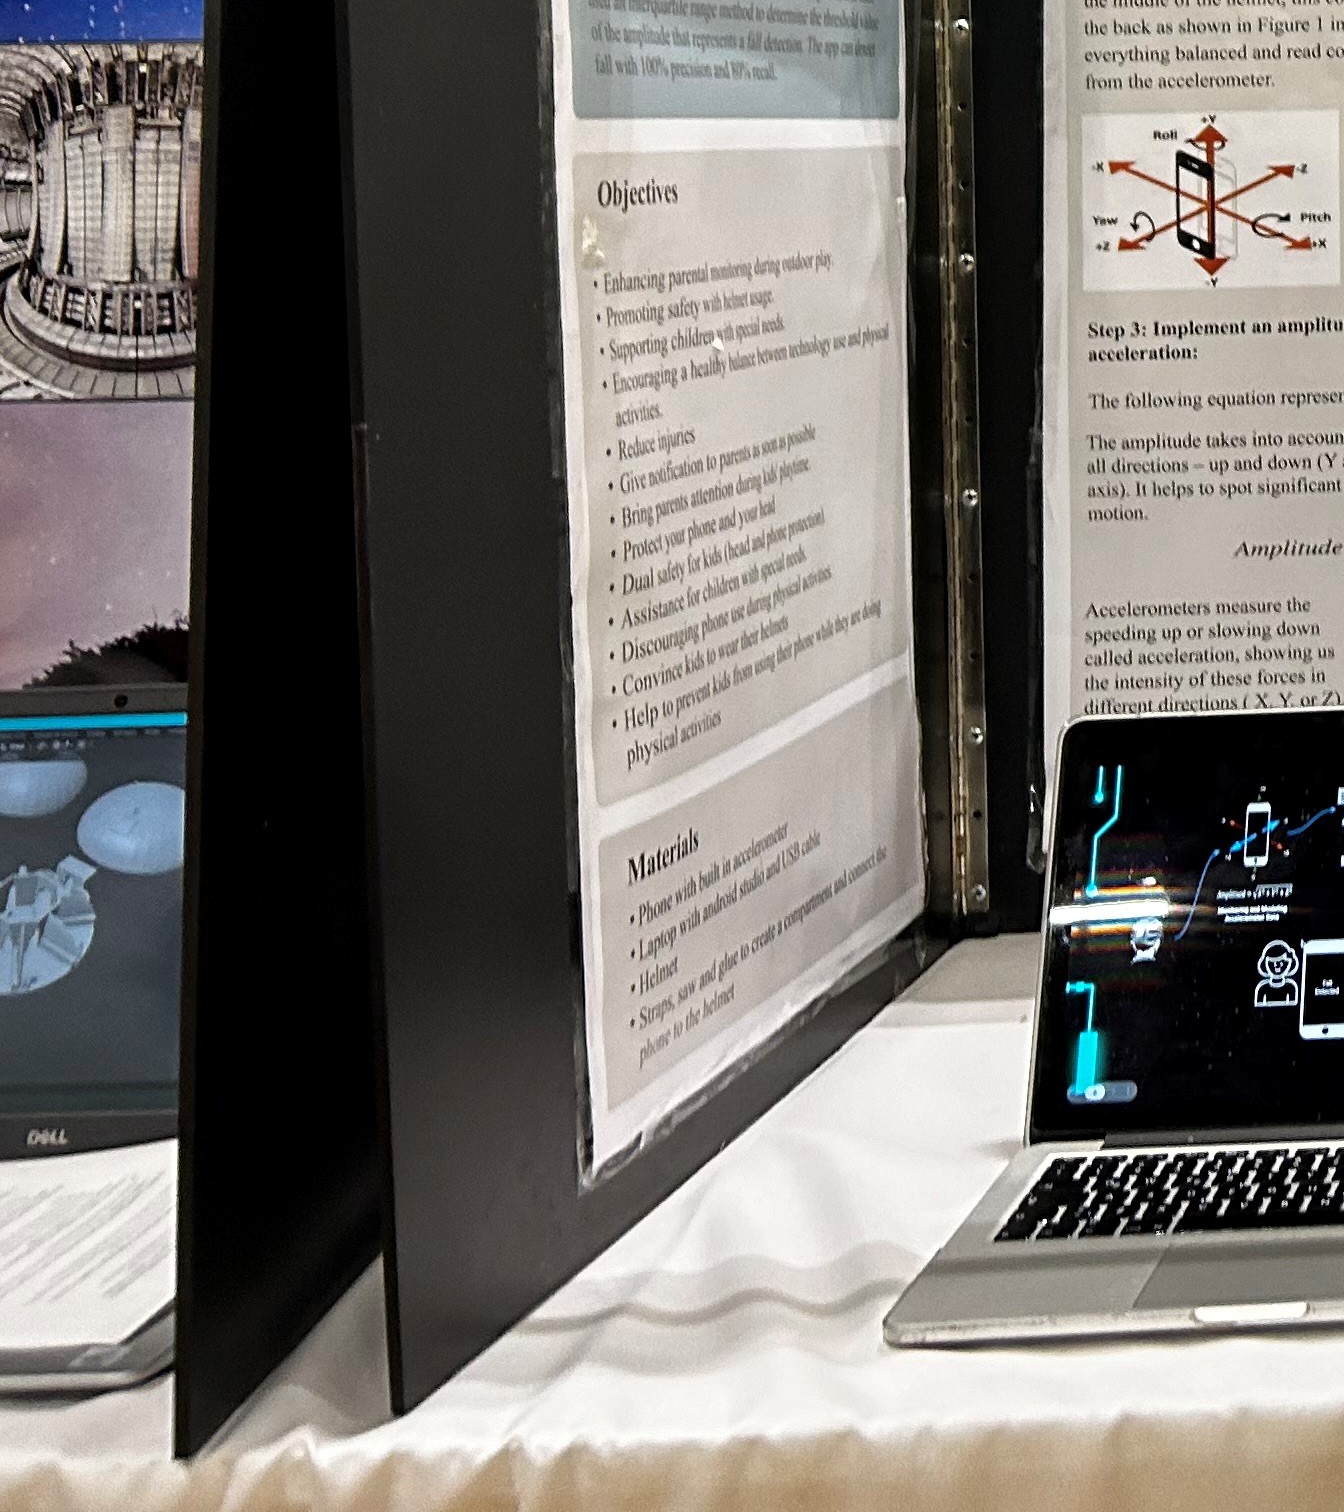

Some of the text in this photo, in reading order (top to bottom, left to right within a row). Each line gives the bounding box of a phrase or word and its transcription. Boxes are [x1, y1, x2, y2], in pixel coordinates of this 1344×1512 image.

[597, 179, 679, 213] Objectives
[603, 262, 709, 295] Enhancing parental
[606, 295, 701, 328] Promoting safety
[608, 328, 715, 364] Supporting children
[1088, 322, 1125, 342] Step
[1131, 321, 1147, 338] 3:
[1153, 319, 1246, 339] Implement
[1251, 322, 1272, 334] an
[612, 361, 679, 394] Encouraging
[1089, 393, 1120, 410] The
[1125, 391, 1203, 411] following
[1207, 390, 1276, 410] equation
[617, 426, 696, 461] Reduce injuries
[1234, 538, 1344, 561] Amplitude
[621, 572, 740, 629] Assistance for children
[1085, 596, 1312, 619] Accelerometers measure the
[624, 702, 659, 732] Help
[627, 827, 700, 887] Materials
[638, 911, 702, 963] Laptop with
[638, 956, 679, 996] Helmet
